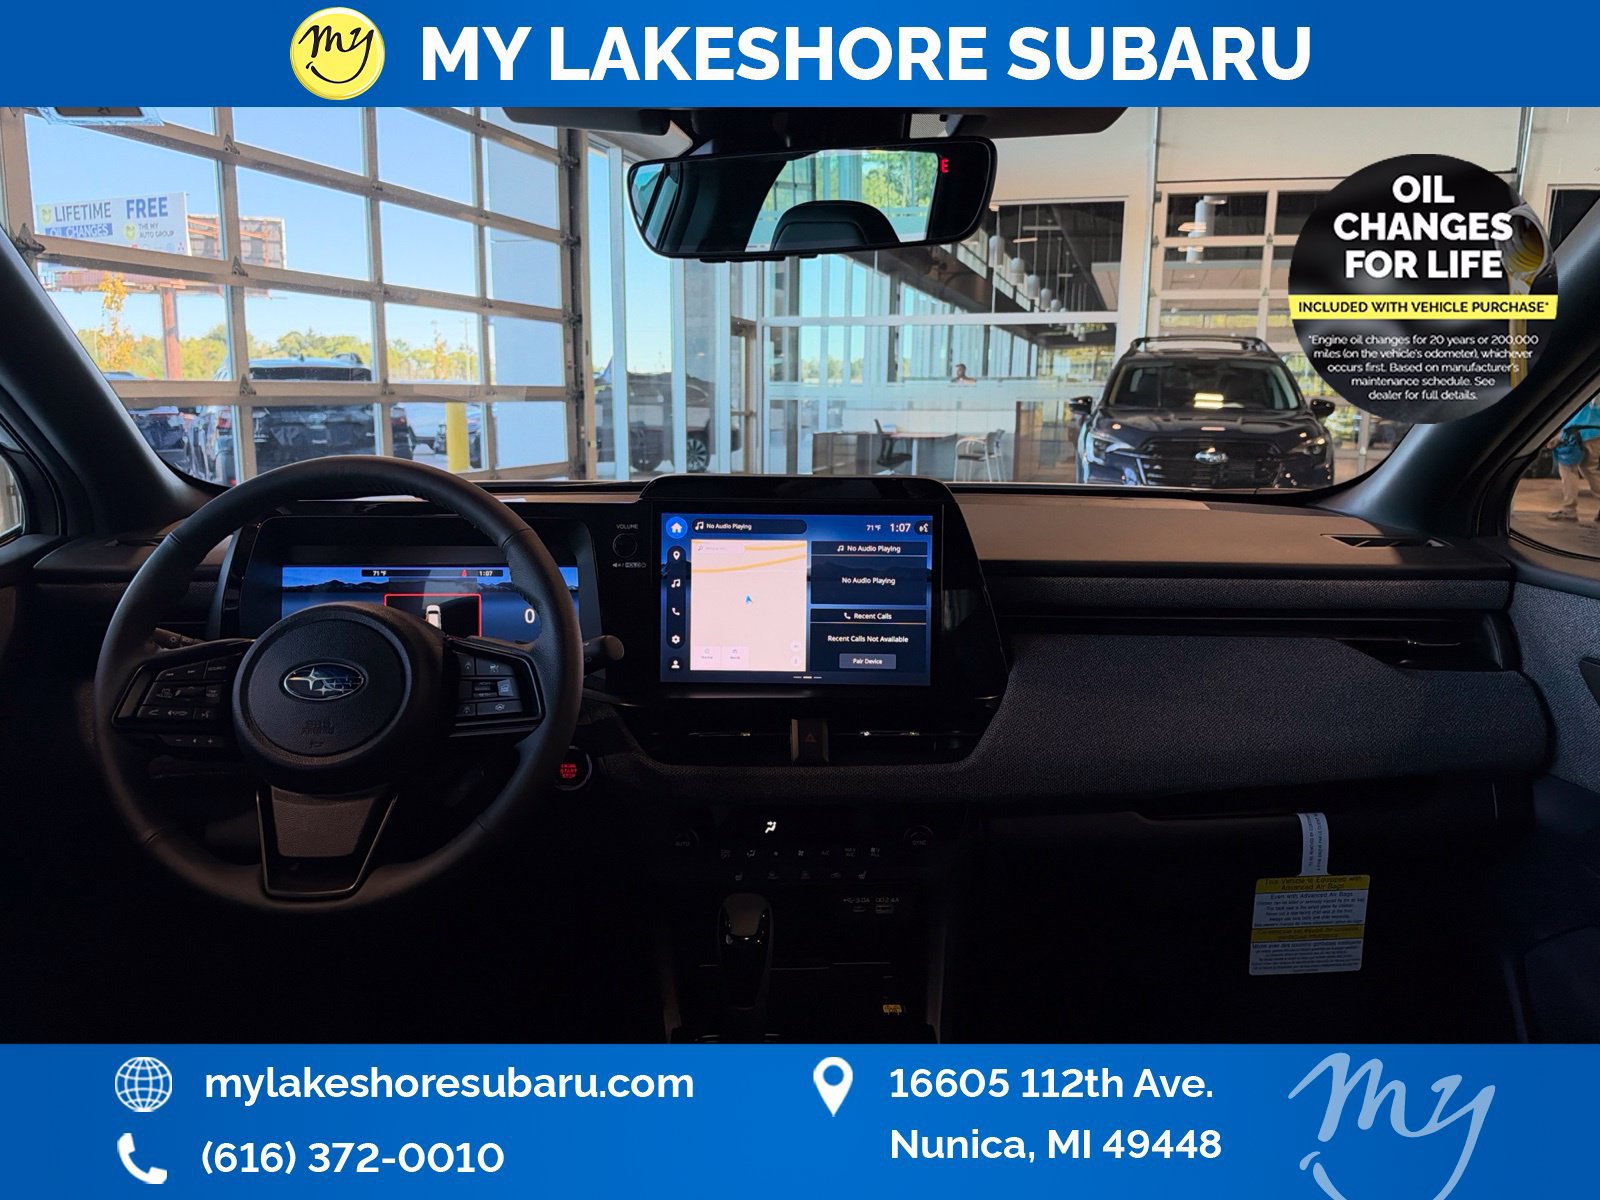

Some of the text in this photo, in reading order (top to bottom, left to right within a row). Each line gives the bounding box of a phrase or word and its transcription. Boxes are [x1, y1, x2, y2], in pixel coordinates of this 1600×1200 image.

[54, 202, 112, 222] LIFETIME
[126, 196, 169, 219] FREE
[66, 224, 110, 237] CHANGES
[139, 229, 175, 239] AUTO GROUP
[706, 523, 752, 533] No Audio Playing
[889, 522, 911, 533] 1:07
[847, 544, 901, 555] No Audio Playing
[841, 576, 896, 587] No Audio Playing
[524, 607, 536, 624] 0
[854, 612, 892, 620] Recent Calls
[827, 635, 909, 643] Recent Calls Not Available
